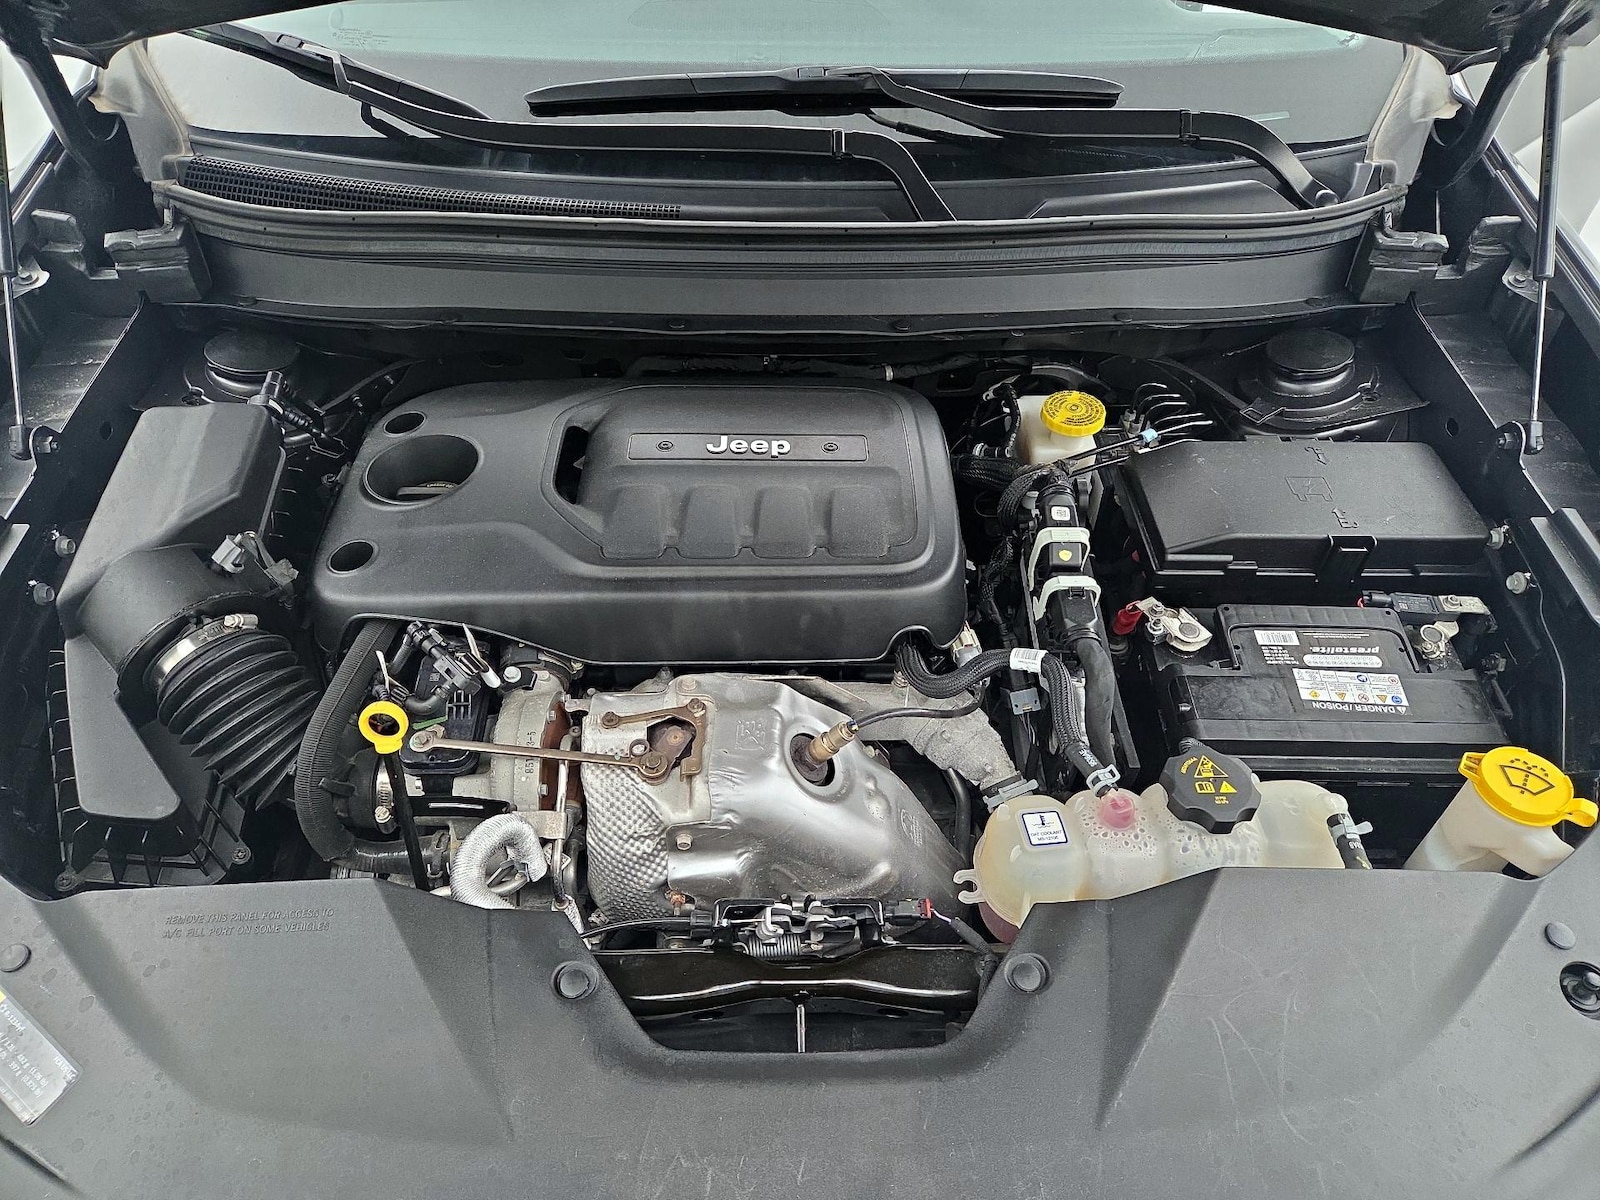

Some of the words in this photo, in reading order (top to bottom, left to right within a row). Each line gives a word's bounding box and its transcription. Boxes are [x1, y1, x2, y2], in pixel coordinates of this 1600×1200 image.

[706, 435, 791, 458] Jeep
[1312, 701, 1349, 711] POISON
[1355, 704, 1396, 714] DANGER
[165, 914, 204, 925] REMOVE
[207, 913, 228, 924] THIS
[230, 911, 260, 922] PANEL
[261, 910, 281, 921] FOR
[282, 908, 320, 920] ACCESS
[322, 907, 335, 918] TO
[162, 928, 183, 939] A/C
[186, 927, 205, 938] FILL
[208, 925, 235, 937] PORT
[237, 925, 250, 936] ON
[254, 923, 282, 935] SOME
[285, 921, 330, 933] VEHICLES
